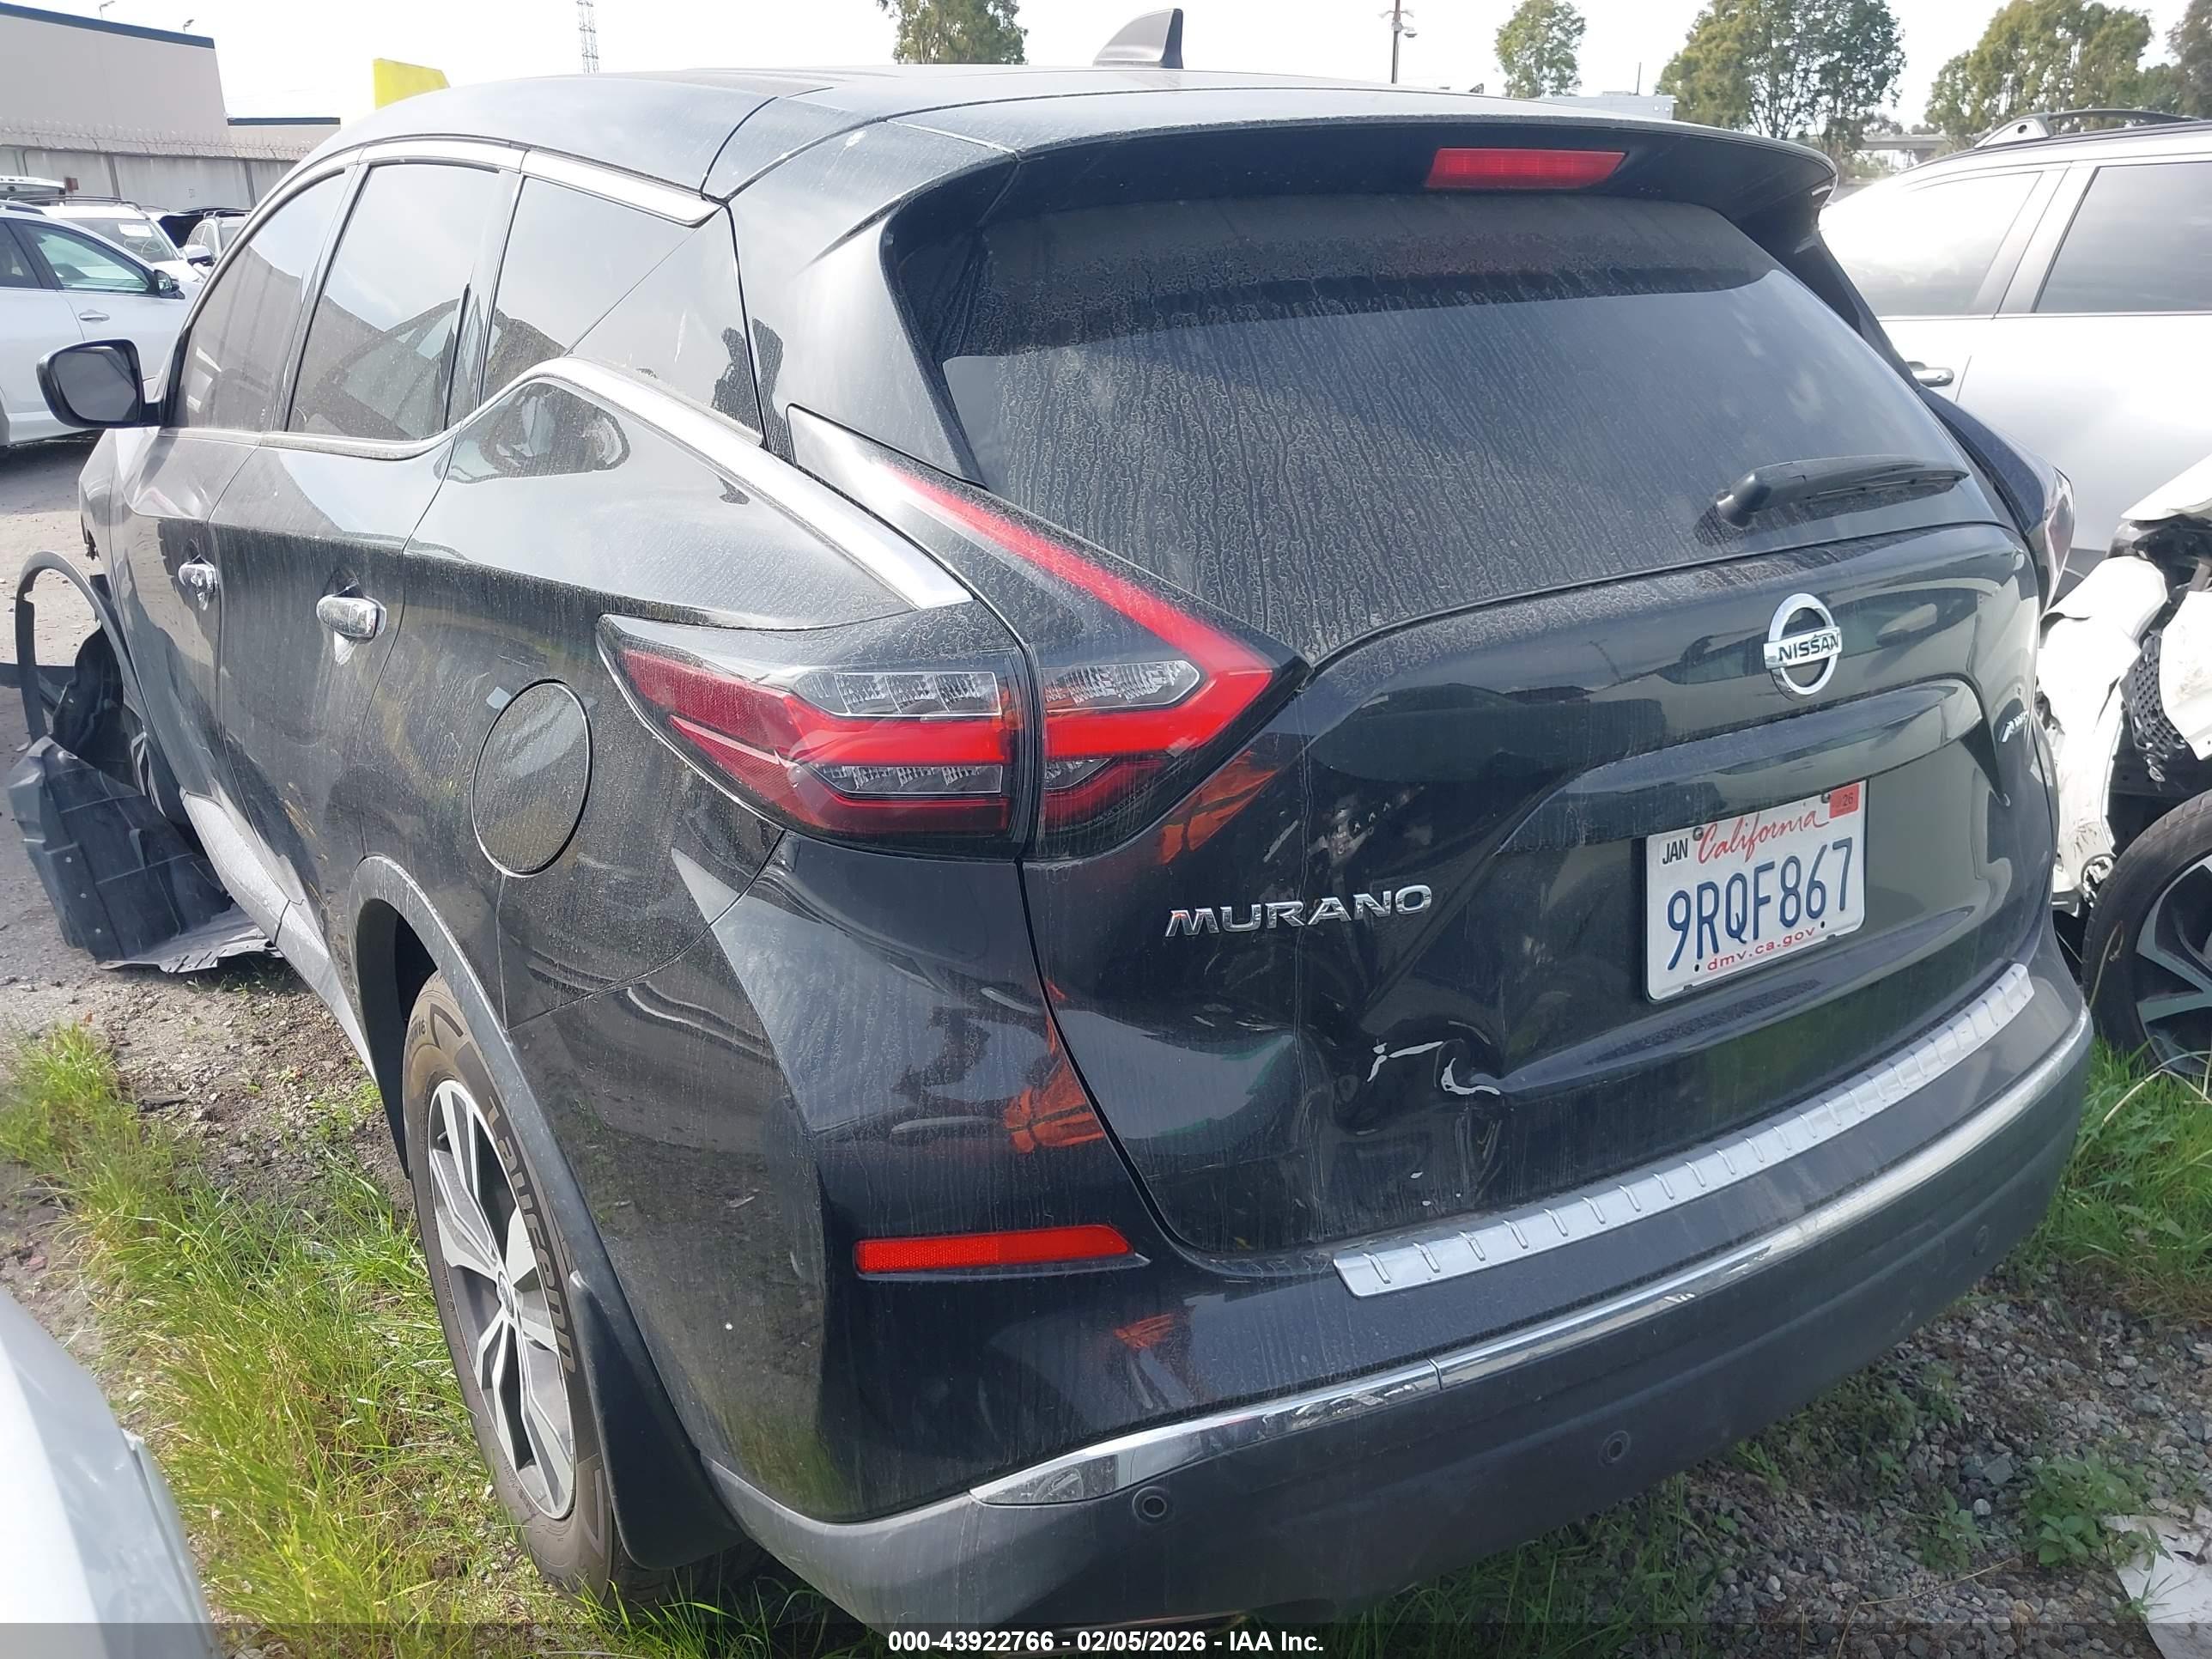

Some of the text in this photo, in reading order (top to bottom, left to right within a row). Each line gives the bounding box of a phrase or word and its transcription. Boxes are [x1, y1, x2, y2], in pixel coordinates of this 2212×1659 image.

[1778, 633, 1840, 661] NISSAN
[1662, 837, 1689, 865] JAN
[1698, 810, 1830, 864] California
[1164, 884, 1432, 937] MURANO
[1667, 836, 1853, 971] 9RQF867
[1706, 927, 1816, 971] dmv.ca.gov
